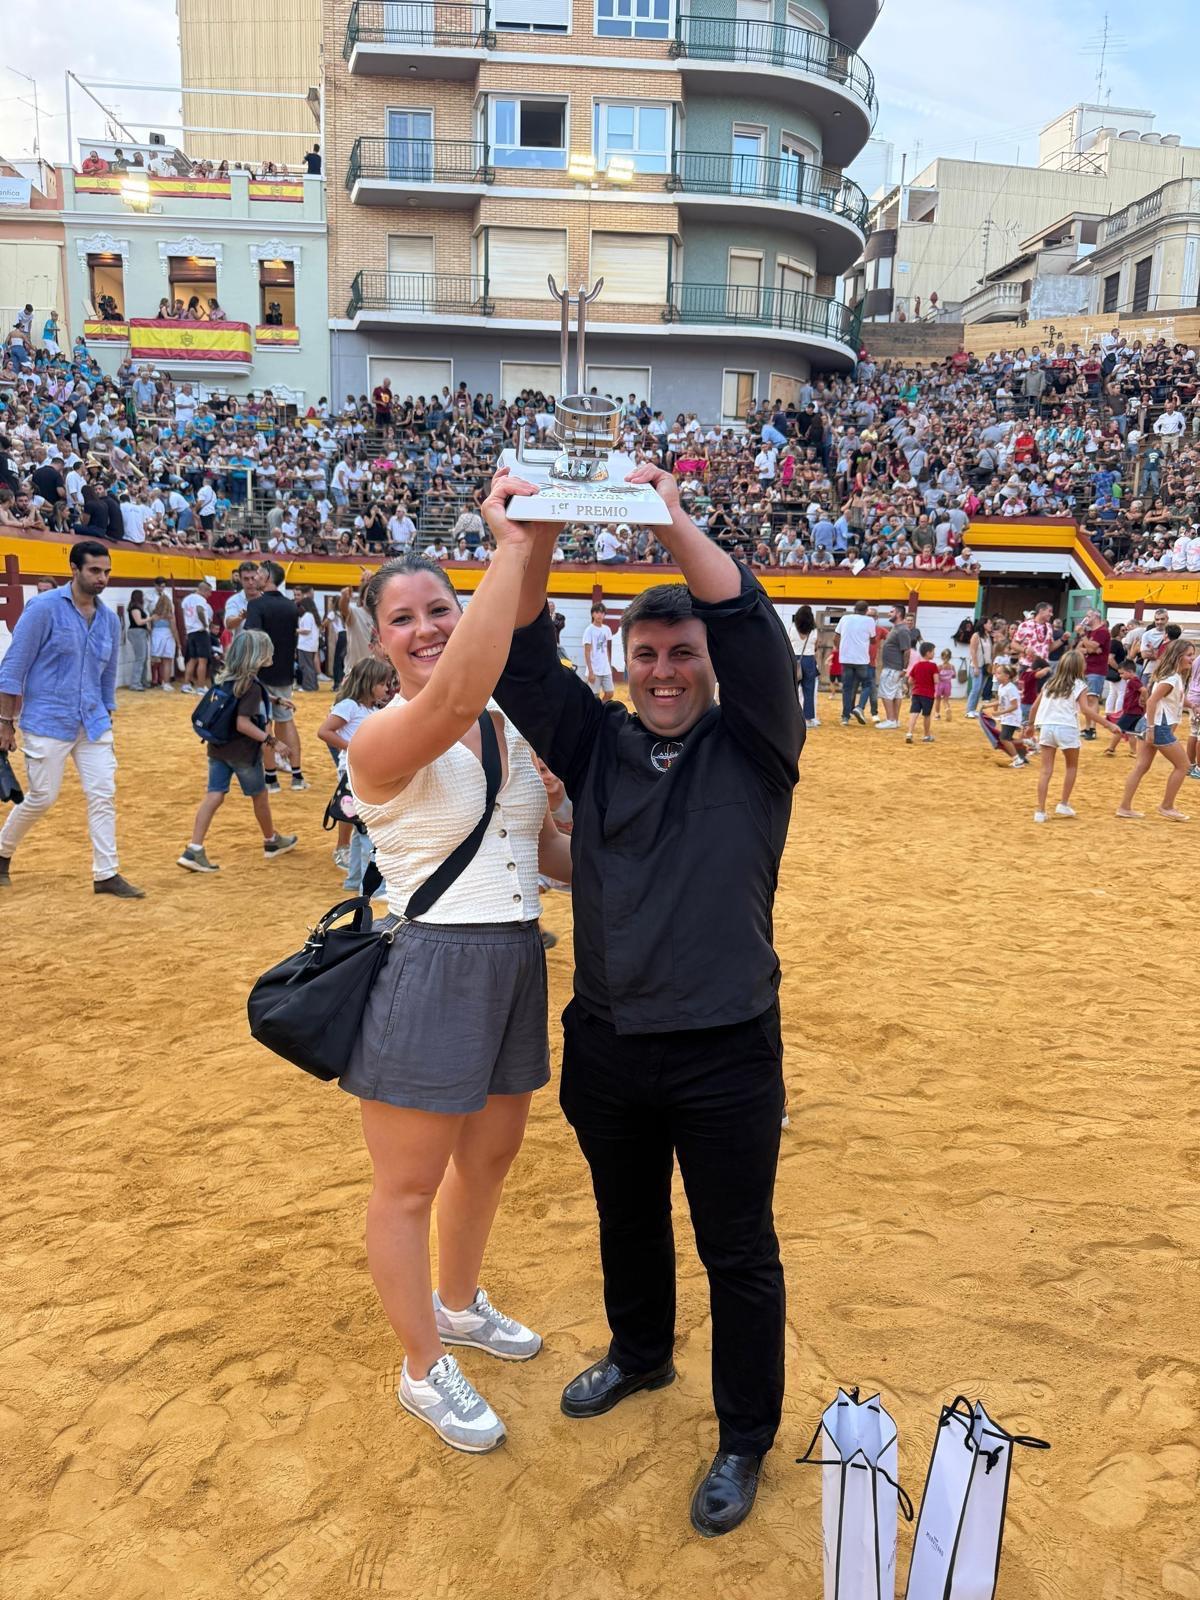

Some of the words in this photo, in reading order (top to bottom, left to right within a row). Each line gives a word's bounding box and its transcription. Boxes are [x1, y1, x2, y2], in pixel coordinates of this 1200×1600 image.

[1042, 325, 1056, 334] TB
[1040, 340, 1055, 349] TB
[576, 505, 628, 517] PREMIO
